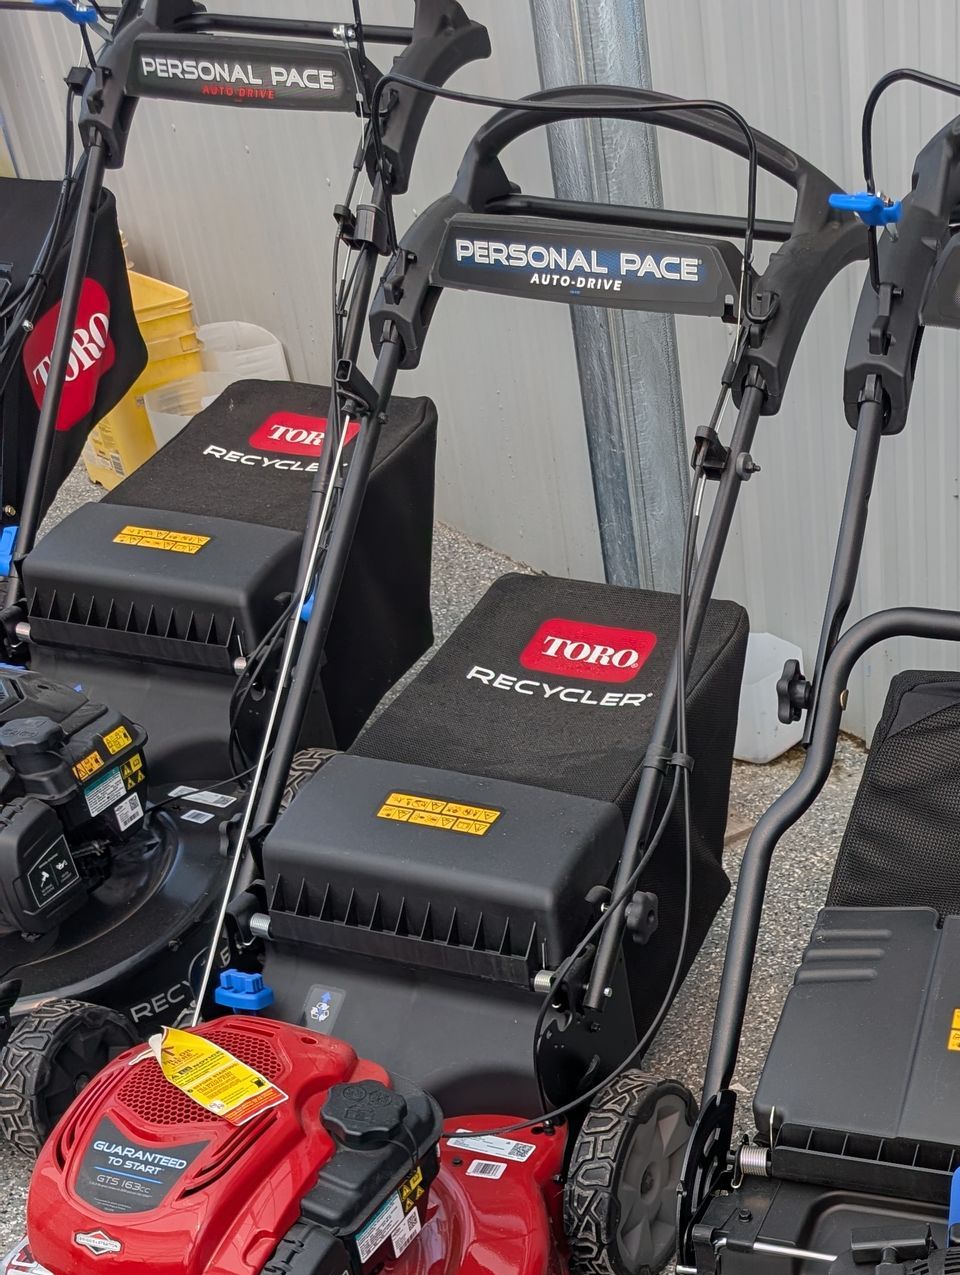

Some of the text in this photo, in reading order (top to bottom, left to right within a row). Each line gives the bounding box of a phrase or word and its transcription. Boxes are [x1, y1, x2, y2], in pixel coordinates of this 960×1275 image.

[141, 57, 335, 90] PERSONAL PACE
[455, 239, 699, 281] PERSONAL PACE
[530, 273, 622, 291] AUTO-DRIVE
[267, 424, 325, 446] TOR
[203, 444, 320, 472] RECYCLE
[542, 636, 639, 668] TORO
[466, 665, 648, 706] RECYCLER
[93, 1141, 187, 1169] GUARANTEED
[108, 1156, 161, 1175] TO START
[97, 1174, 120, 1186] GTS
[121, 1179, 151, 1194] 163cc
